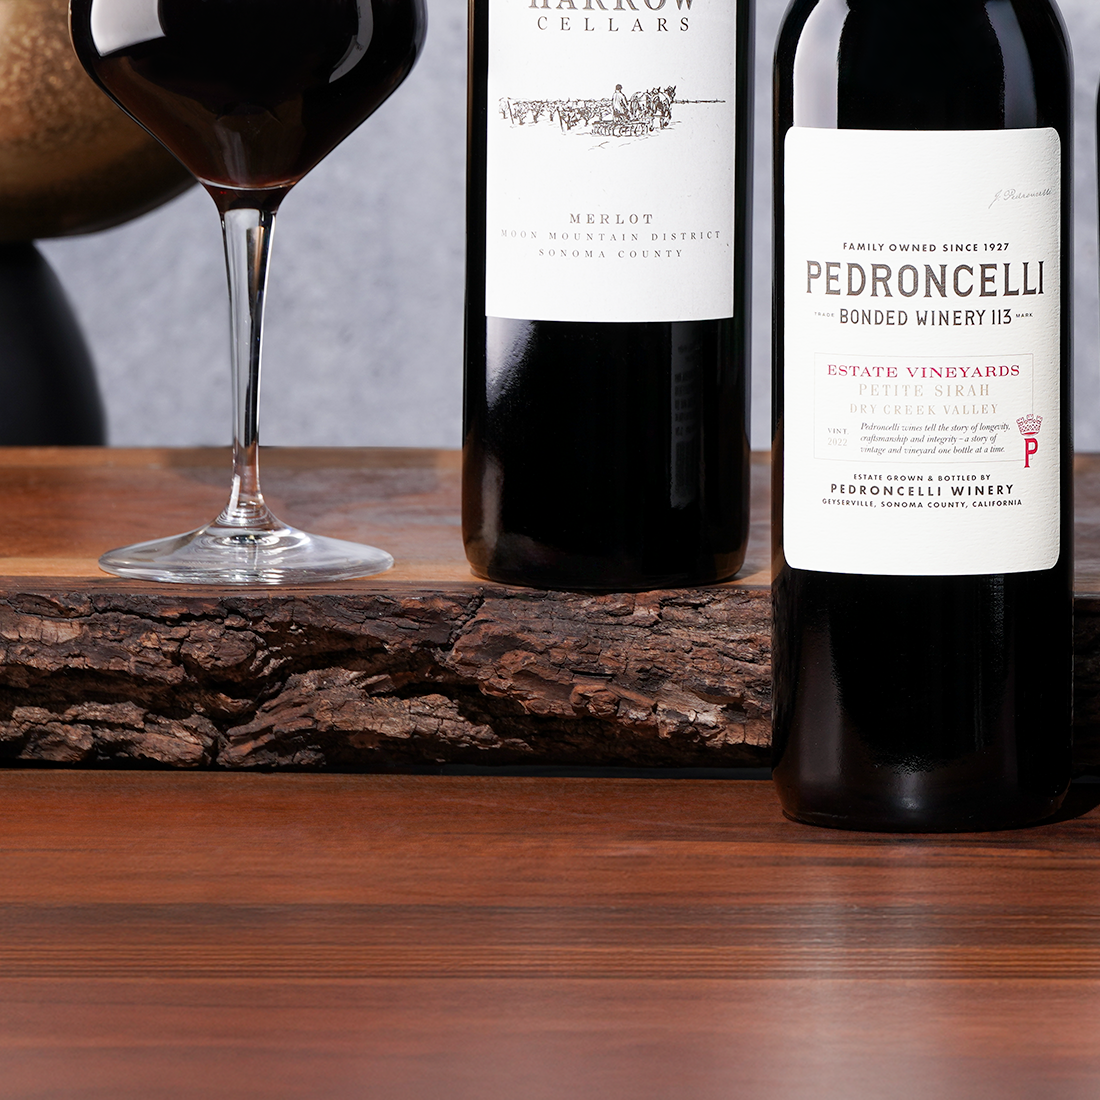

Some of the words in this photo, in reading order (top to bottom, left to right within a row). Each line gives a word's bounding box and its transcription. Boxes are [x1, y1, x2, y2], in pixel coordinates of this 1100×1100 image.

[538, 17, 688, 31] CELLARS
[570, 214, 652, 224] MERLOT
[502, 230, 536, 238] MOON
[549, 233, 638, 241] MOUNTAIN
[652, 231, 720, 240] DISTRICT
[844, 243, 884, 251] FAMILY
[889, 244, 936, 252] OWNED
[943, 244, 977, 252] SINCE
[984, 243, 1009, 251] 1927
[539, 249, 605, 257] SONOMA
[618, 250, 681, 258] COUNTY
[807, 261, 1044, 297] PEDRONCELLI
[840, 309, 907, 325] BONDED
[916, 310, 986, 325] WINERY
[992, 309, 1011, 324] 113
[829, 365, 897, 377] ESTATE
[907, 365, 1019, 377] VINEYARDS
[860, 384, 923, 396] PETITE
[935, 384, 988, 396] SIRAH
[850, 404, 875, 413] DRY
[884, 405, 935, 415] CREEK
[944, 404, 997, 414] VALLEY
[861, 423, 899, 431] Pedroncelli
[951, 425, 967, 433] story
[971, 423, 979, 433] of
[828, 438, 847, 446] 2022
[860, 435, 908, 445] craftsmanship
[927, 436, 957, 445] integrity
[990, 433, 998, 444] of
[861, 447, 886, 455] vintage
[904, 446, 936, 456] vineyard
[1024, 438, 1038, 468] P
[831, 484, 940, 496] PEDRONCELLI
[951, 485, 1013, 496] WINERY
[822, 498, 876, 507] GEYSERVILLE,
